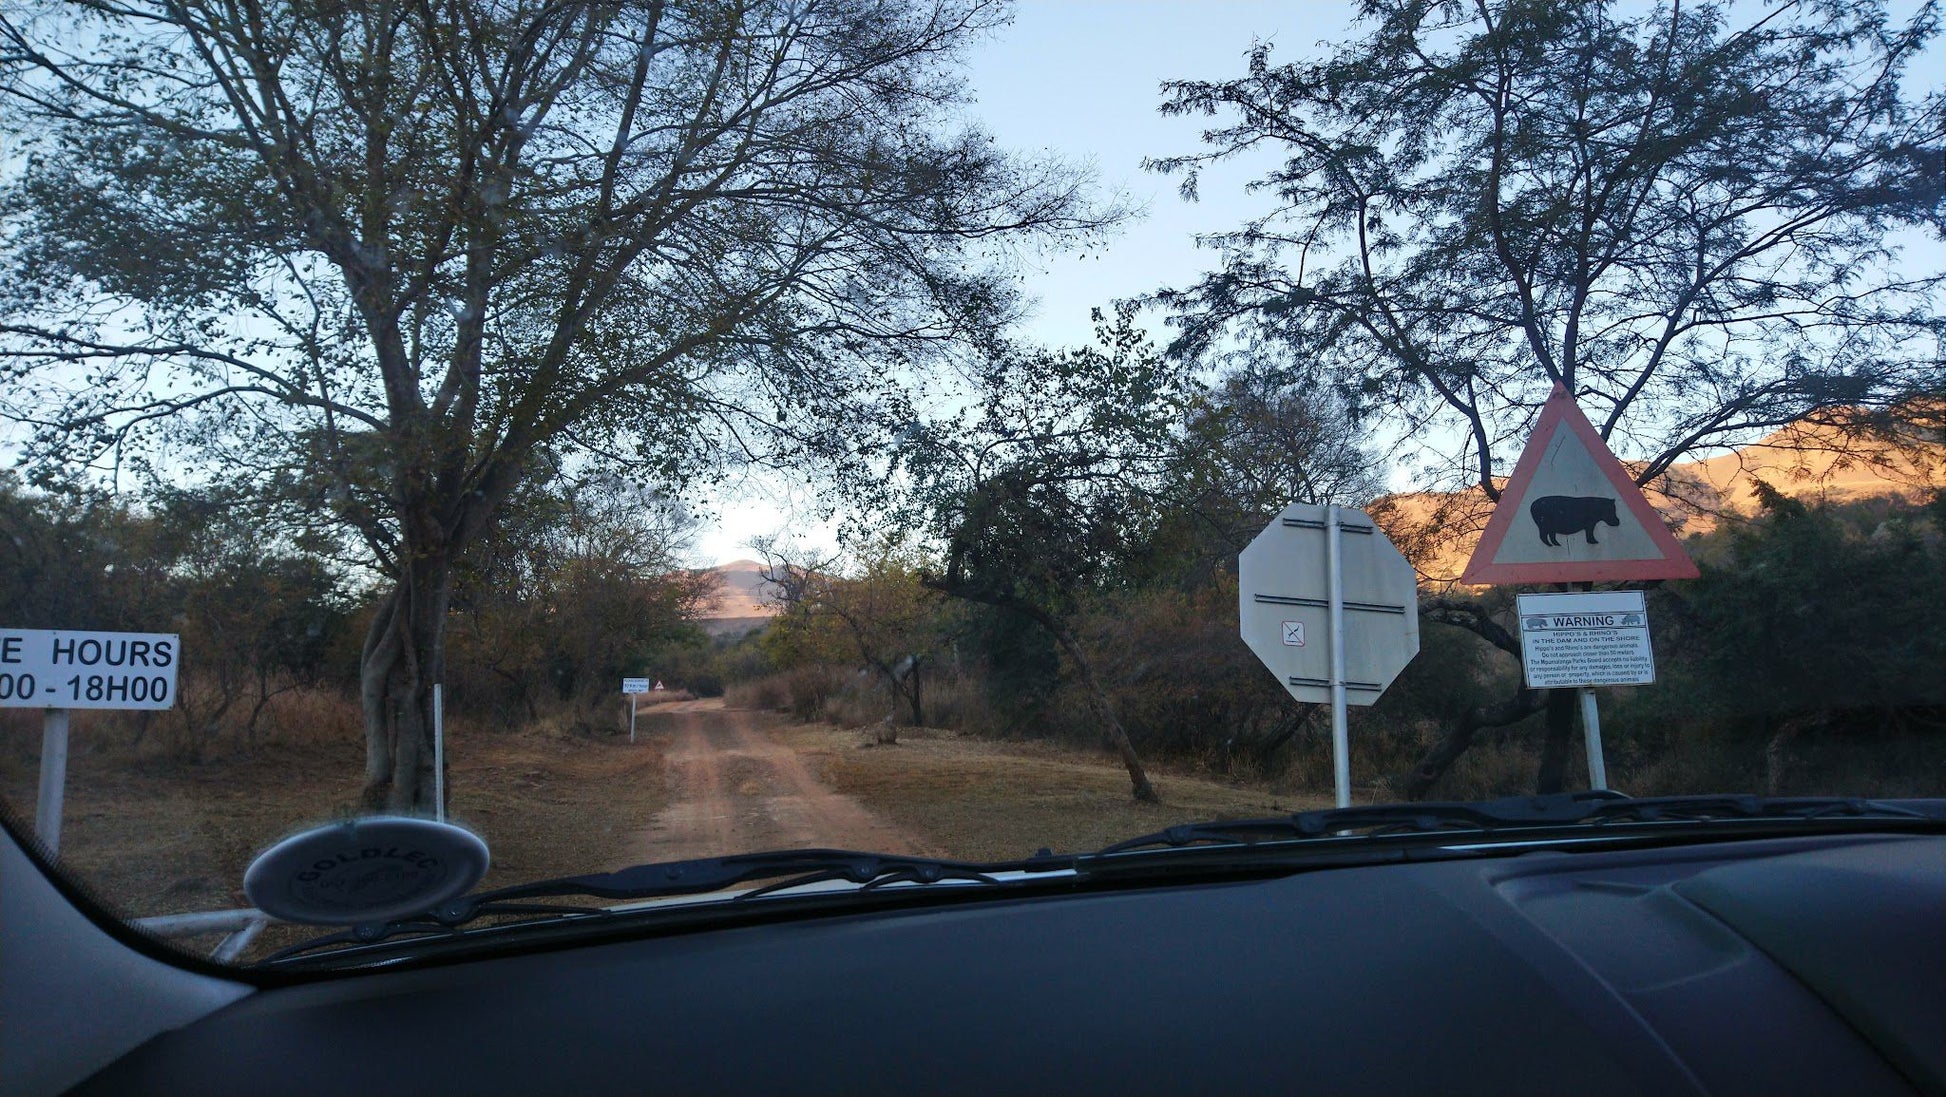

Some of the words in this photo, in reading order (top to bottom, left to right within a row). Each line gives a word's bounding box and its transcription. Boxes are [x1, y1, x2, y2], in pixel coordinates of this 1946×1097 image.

[1553, 616, 1614, 627] WARNING
[0, 637, 23, 664] E
[52, 638, 172, 667] HOURS
[67, 674, 168, 702] 18H00
